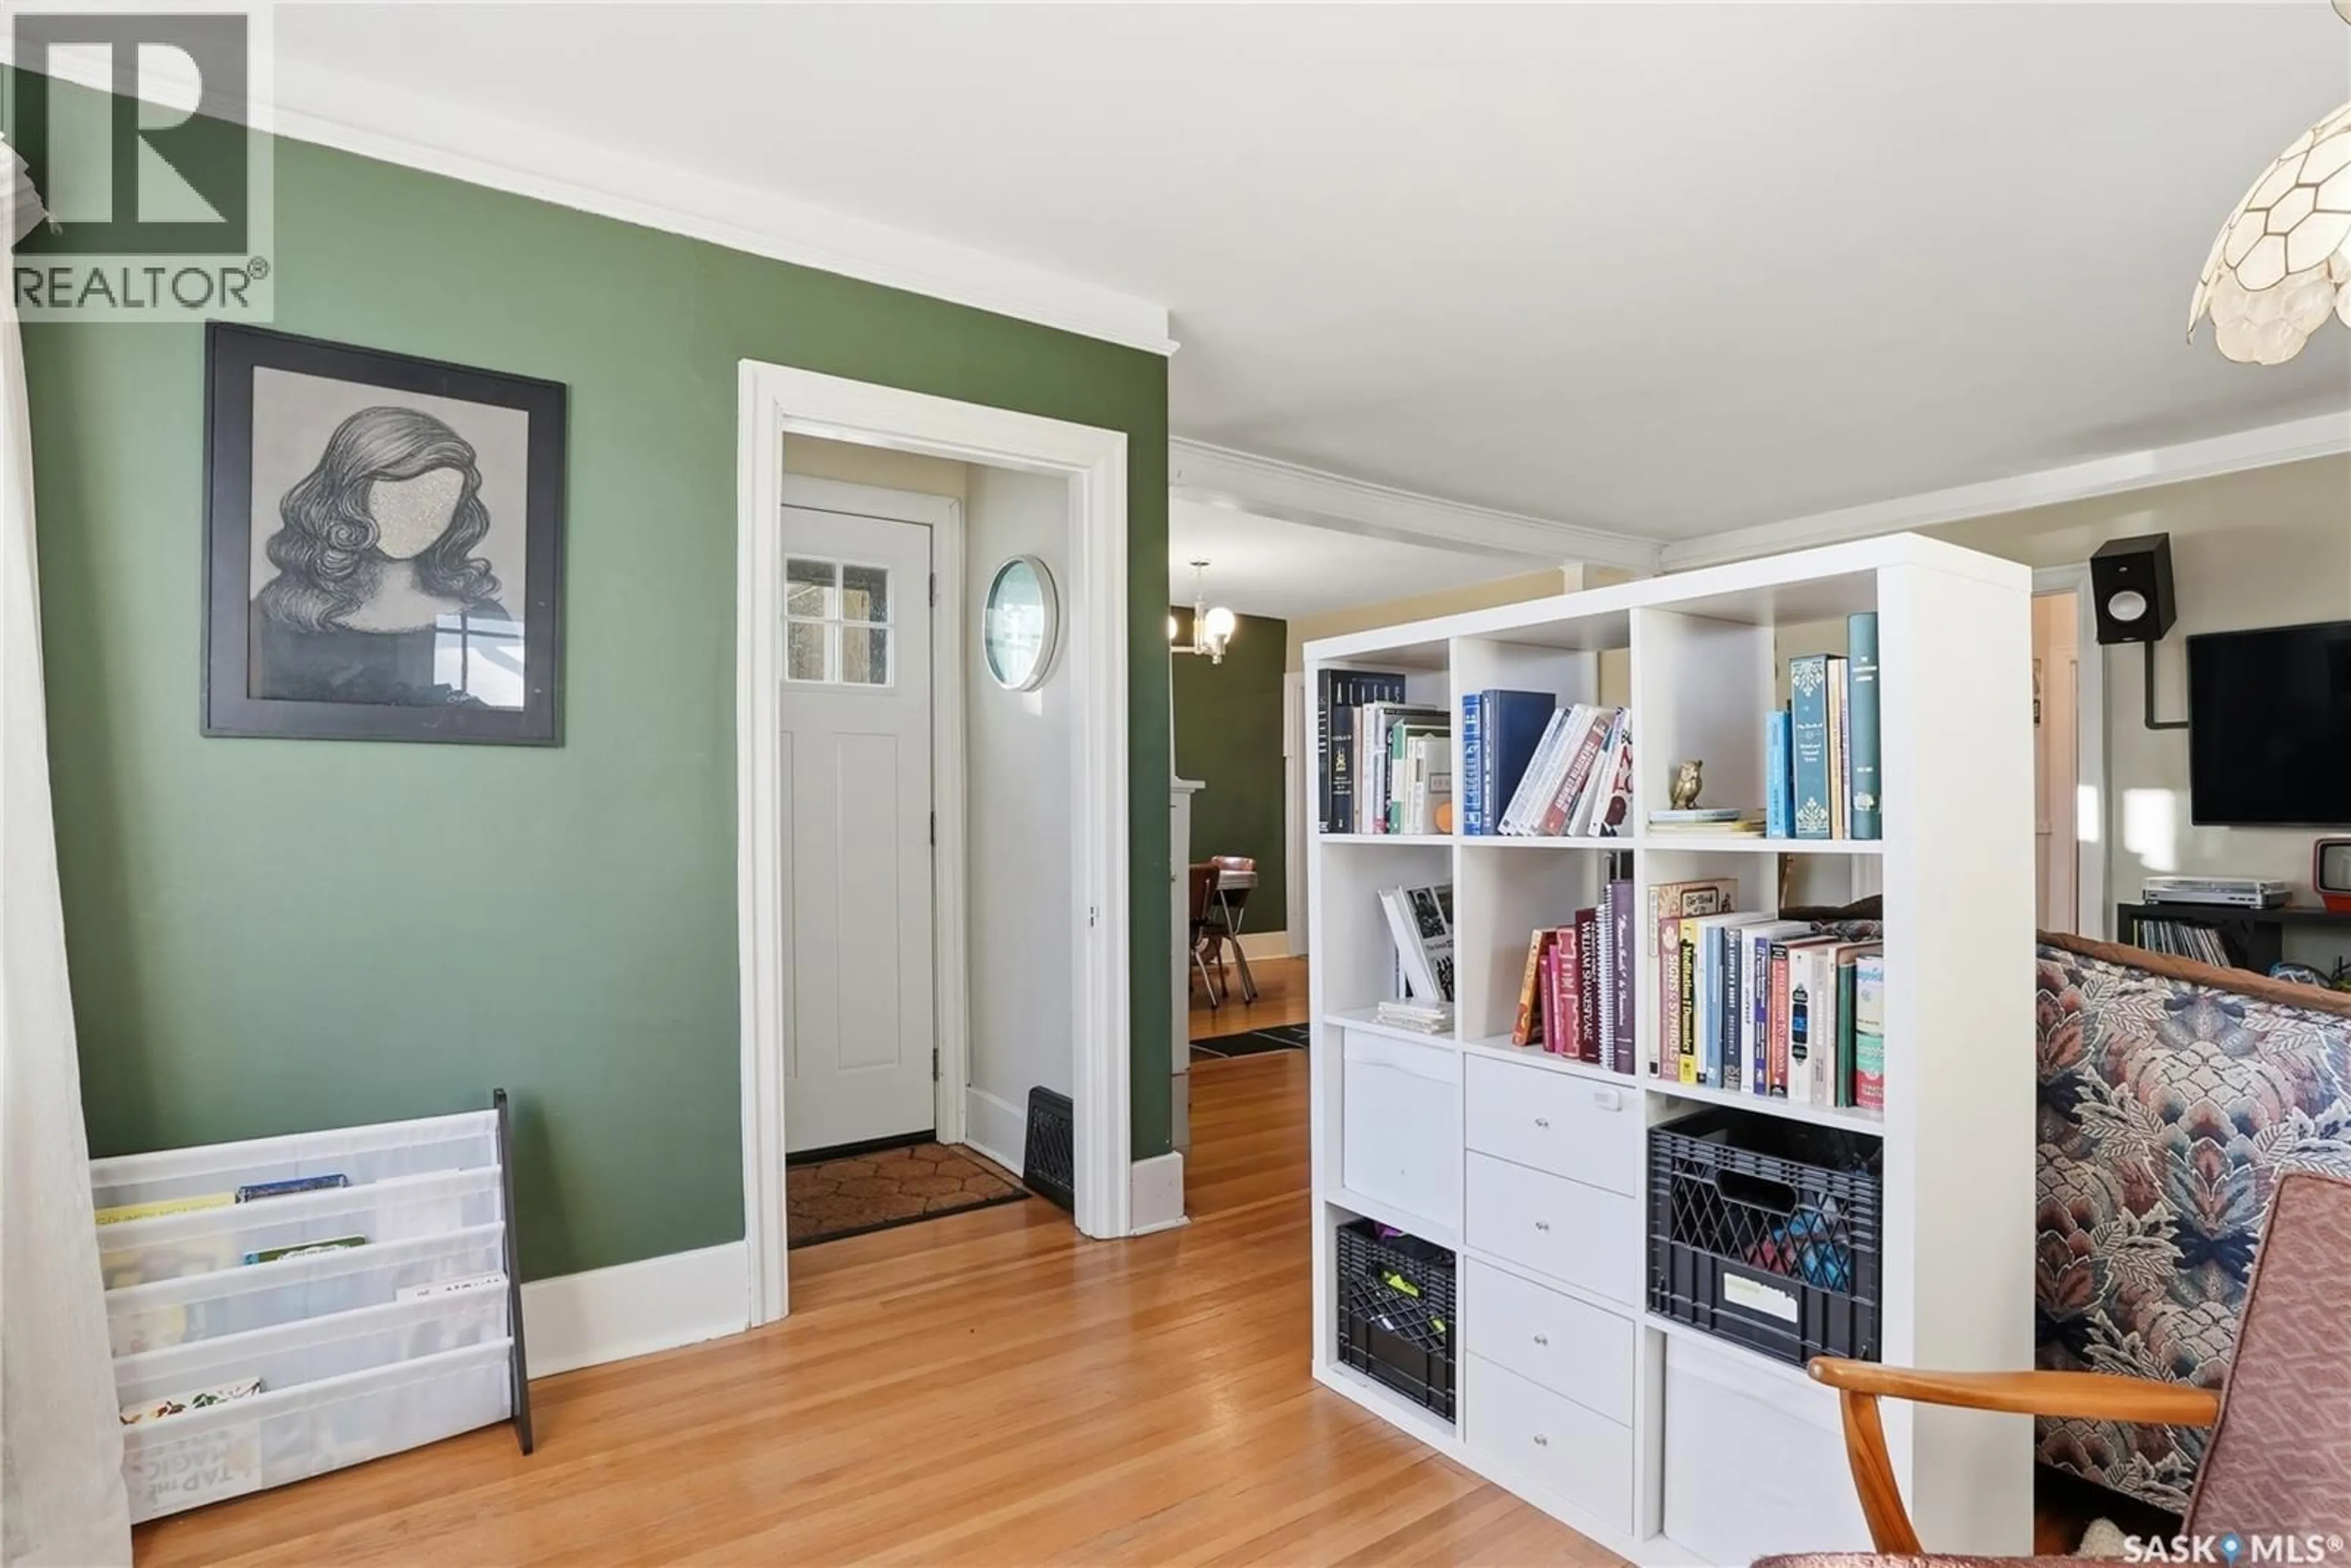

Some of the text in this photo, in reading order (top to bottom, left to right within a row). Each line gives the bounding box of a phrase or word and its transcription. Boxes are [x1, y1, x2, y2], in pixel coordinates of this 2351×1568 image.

[1581, 921, 1593, 1041] WILLIAM SHAKESPEARE
[1668, 954, 1679, 991] SIGNS
[1682, 946, 1693, 998] Meditation
[1668, 1002, 1679, 1062] SYMBOLS
